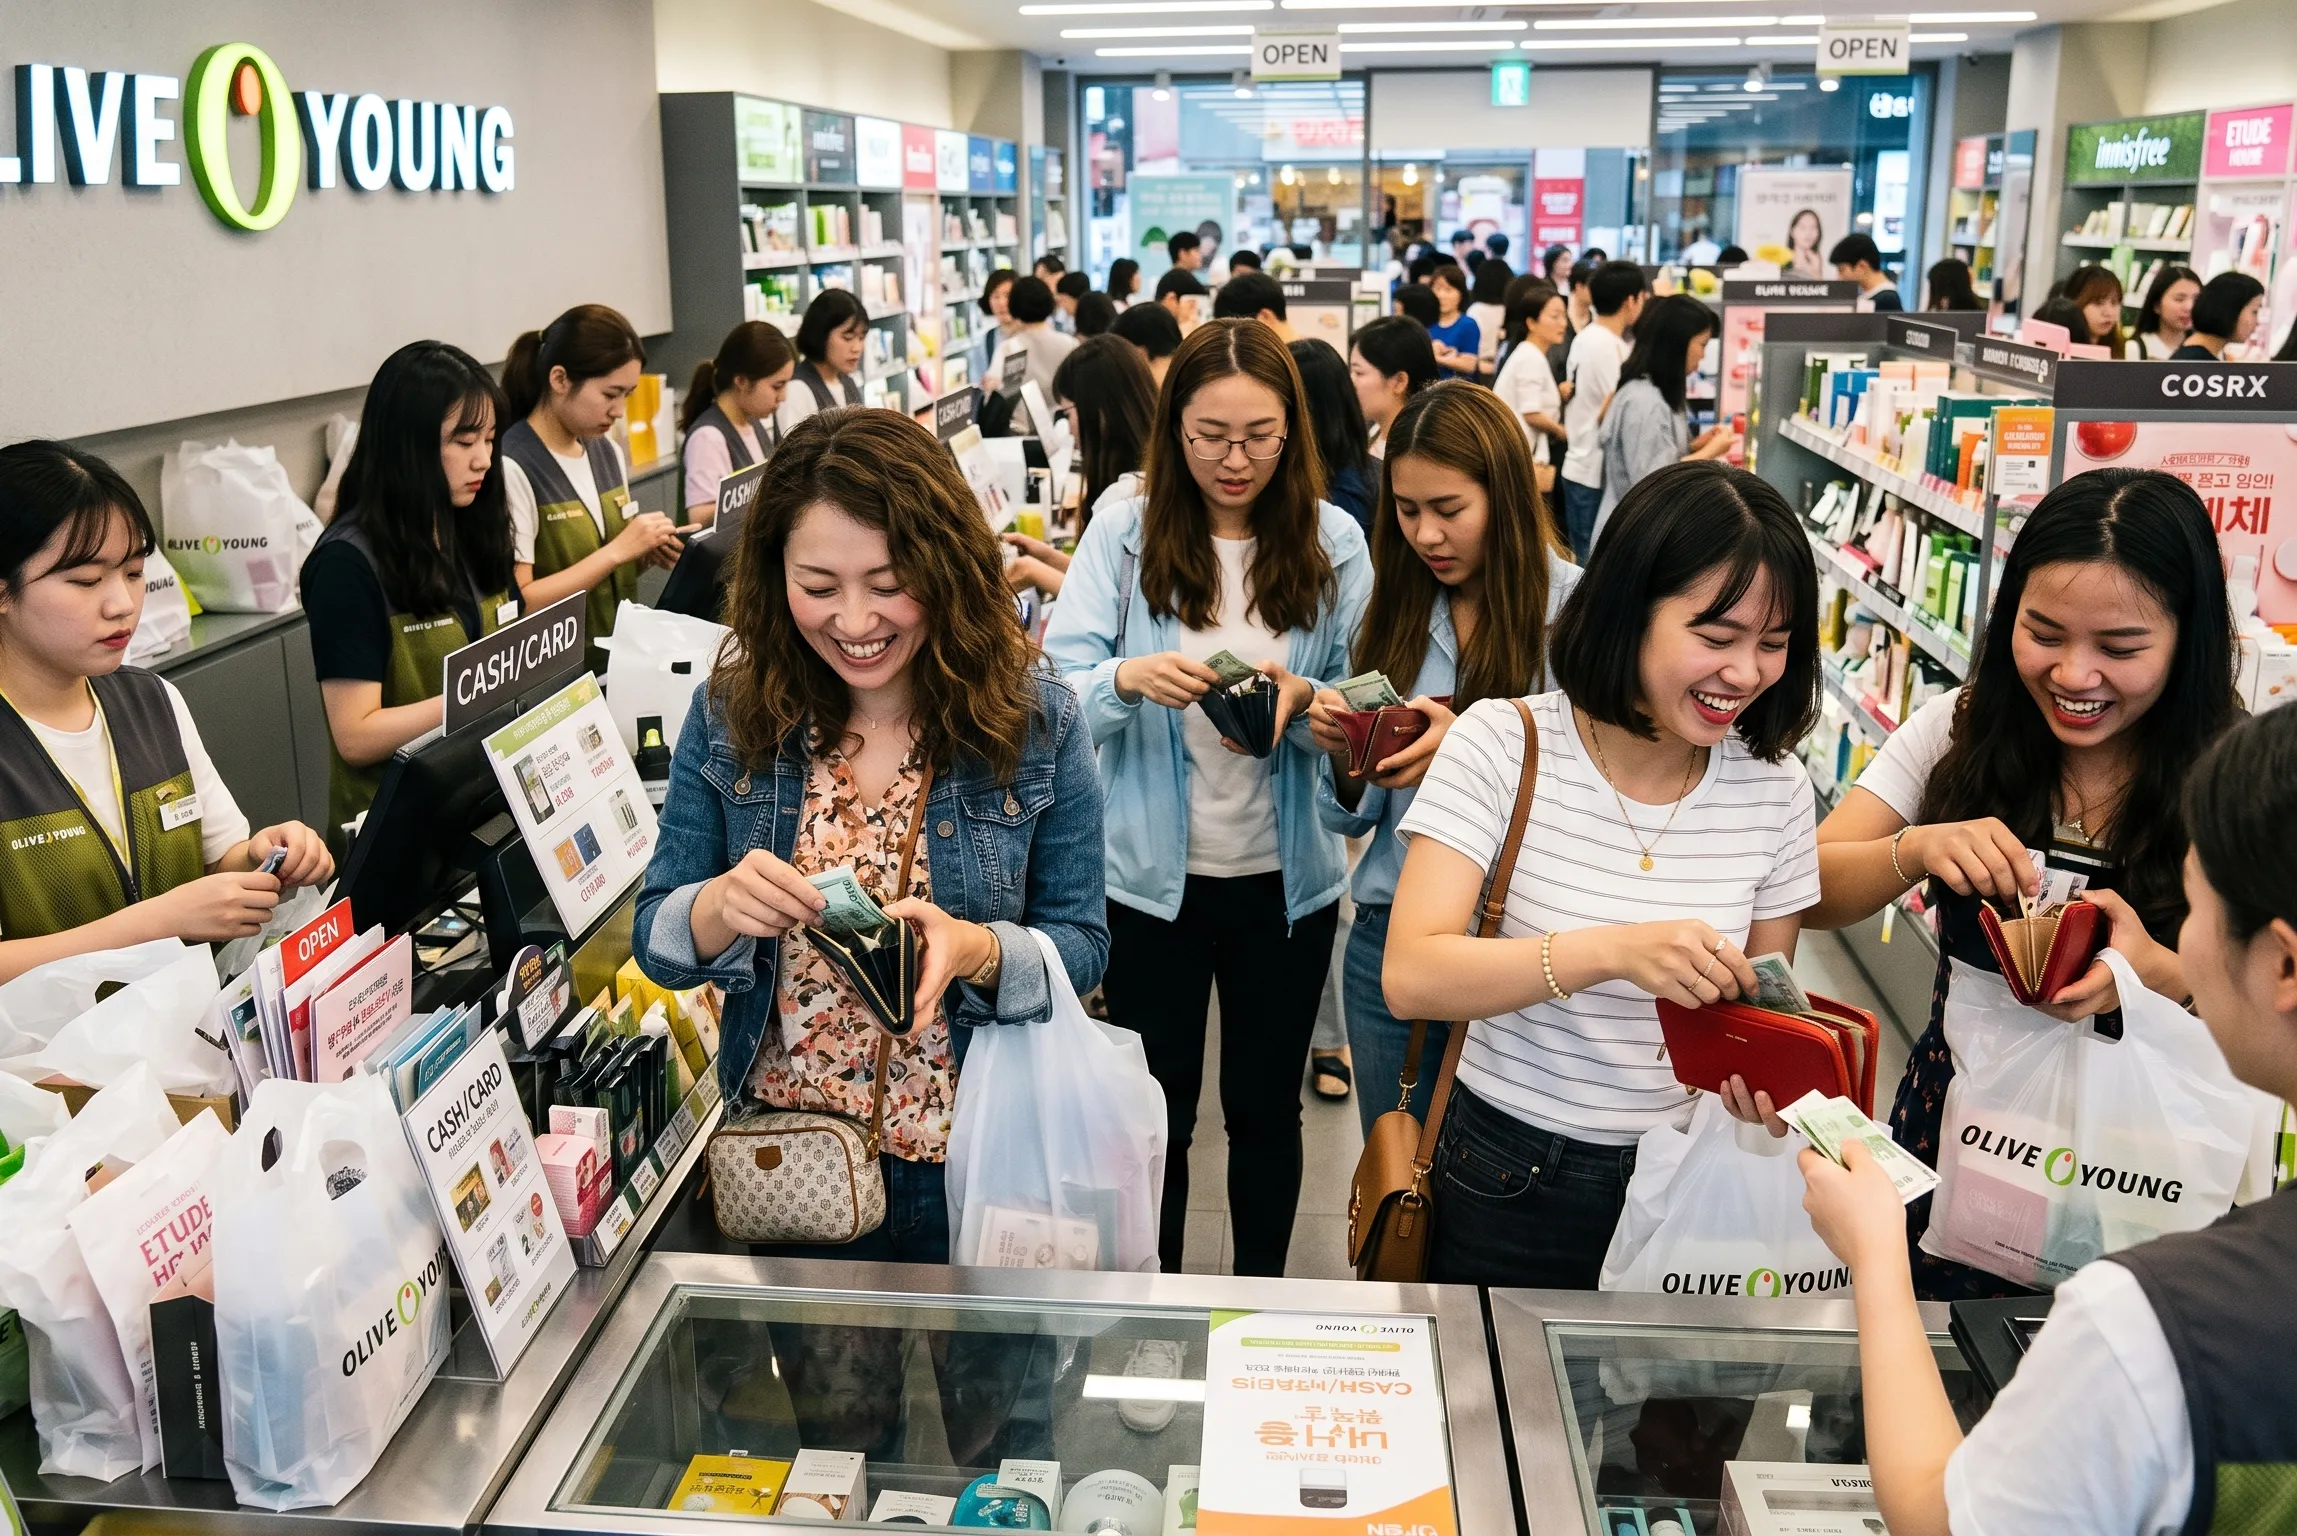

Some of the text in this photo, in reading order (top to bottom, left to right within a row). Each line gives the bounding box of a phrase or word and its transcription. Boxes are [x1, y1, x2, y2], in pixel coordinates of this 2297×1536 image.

[1263, 44, 1328, 65] OPEN
[1829, 38, 1897, 59] OPEN
[299, 90, 516, 192] YOUNG
[2095, 126, 2171, 174] innisfree
[2225, 116, 2273, 147] ETUDE
[2161, 374, 2269, 398] COSRX
[222, 536, 268, 550] YOUNG
[456, 615, 578, 707] CASH/CARD
[11, 825, 86, 850] OLIVE YOUNG
[298, 916, 339, 962] OPEN
[427, 1062, 502, 1153] CASH/CARD
[1960, 1125, 2183, 1203] OLIVE YOUNG
[139, 1195, 213, 1268] ETUDE
[1661, 1265, 1853, 1296] OLIVE YOUN
[342, 1308, 398, 1377] OLIVE
